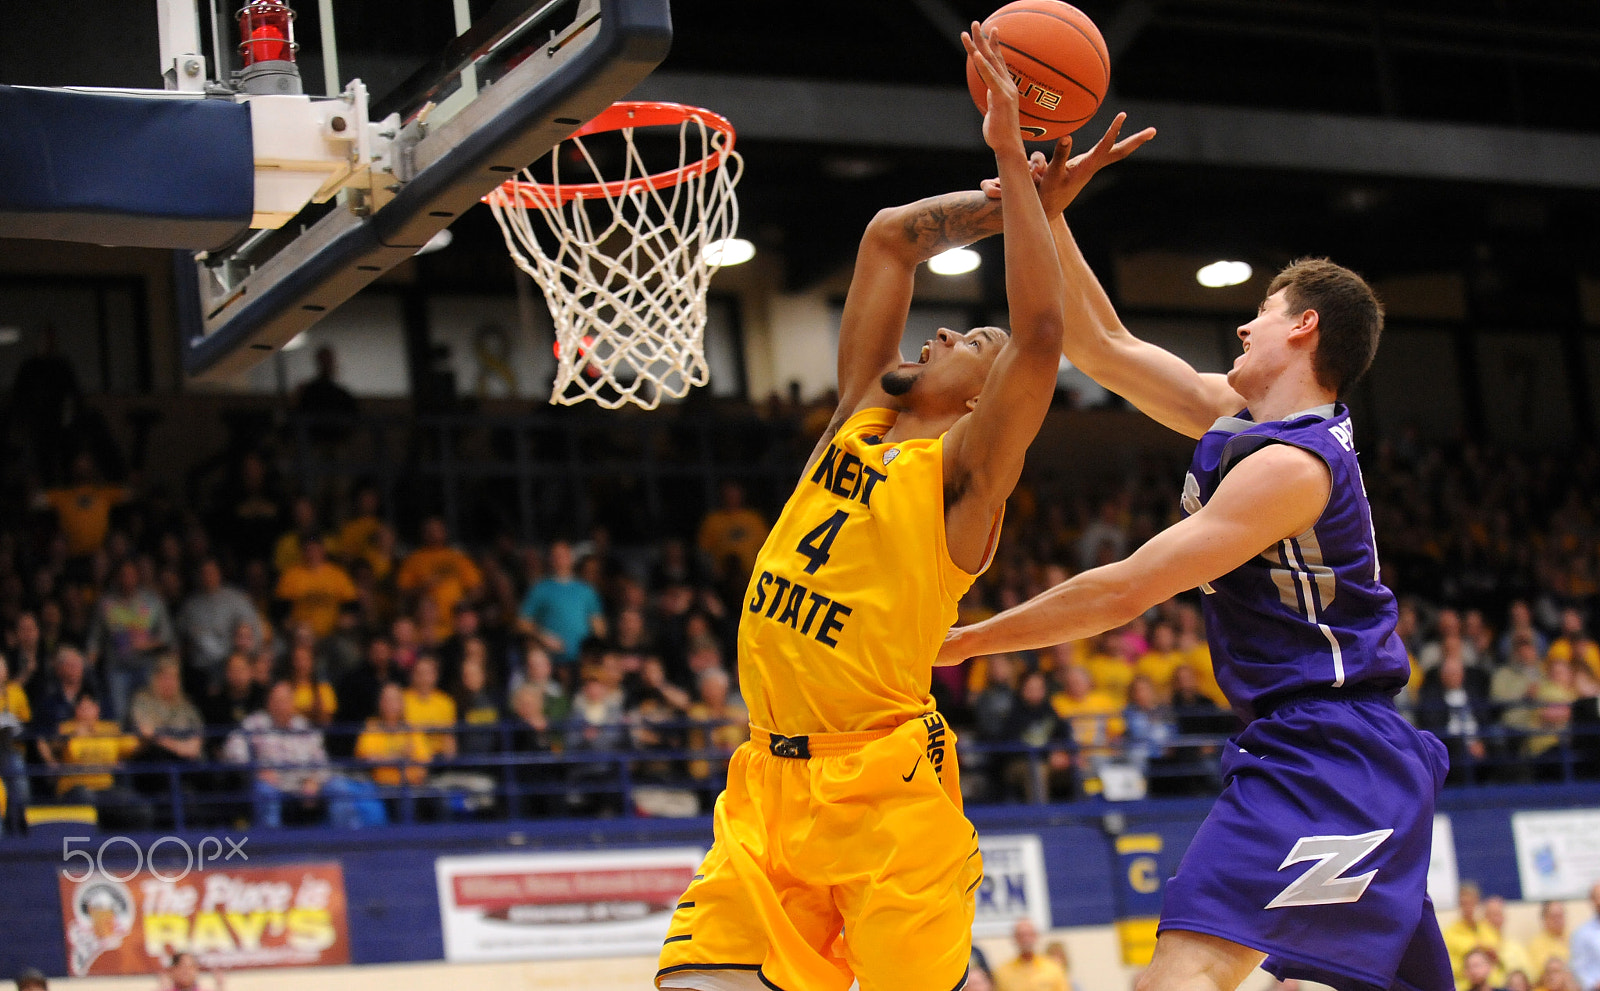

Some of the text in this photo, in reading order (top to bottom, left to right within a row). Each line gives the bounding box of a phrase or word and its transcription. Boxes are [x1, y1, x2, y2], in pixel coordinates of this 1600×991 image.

[796, 509, 850, 575] 4
[749, 570, 853, 649] STATE
[1128, 856, 1161, 894] C
[1264, 828, 1394, 909] Z
[142, 908, 336, 957] RAY'S
